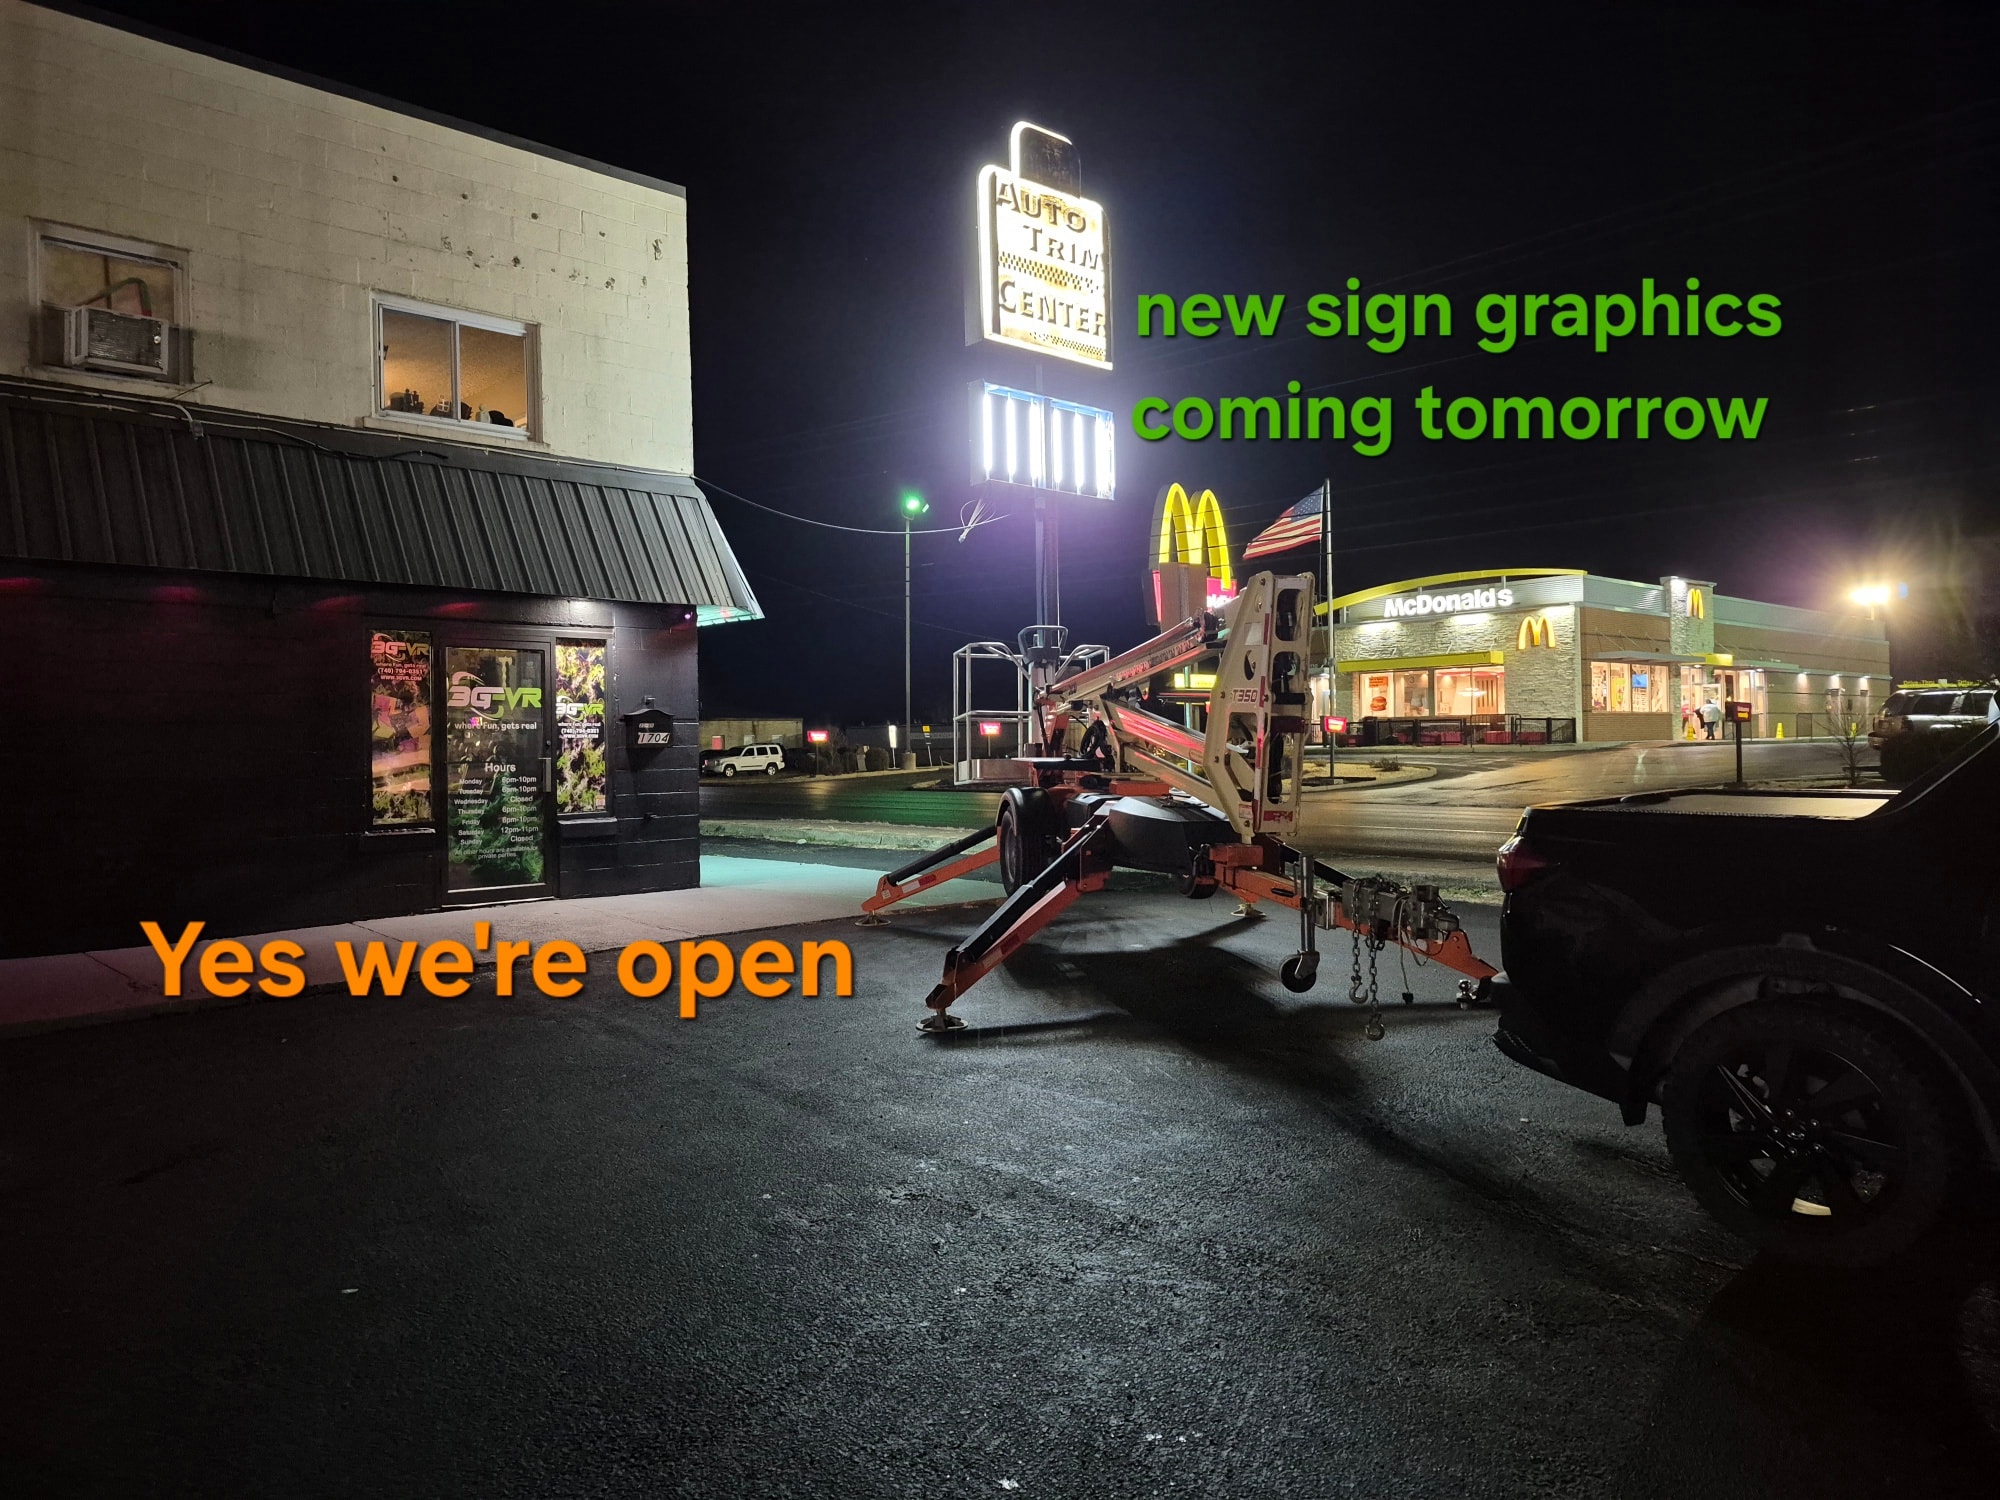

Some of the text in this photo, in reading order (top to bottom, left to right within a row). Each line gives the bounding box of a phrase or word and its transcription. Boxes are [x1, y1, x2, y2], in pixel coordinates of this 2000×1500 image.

[996, 182, 1086, 233] AUTO
[999, 279, 1106, 337] CENTER
[1384, 588, 1514, 618] McDonalds
[1232, 688, 1258, 703] T350
[454, 721, 481, 729] where
[501, 722, 520, 731] gets
[521, 721, 537, 729] real
[641, 733, 670, 742] 1704
[484, 762, 517, 772] Hours
[509, 795, 533, 803] Closed
[500, 825, 539, 834] 12pm-11pm
[460, 835, 534, 846] Sunday Closed
